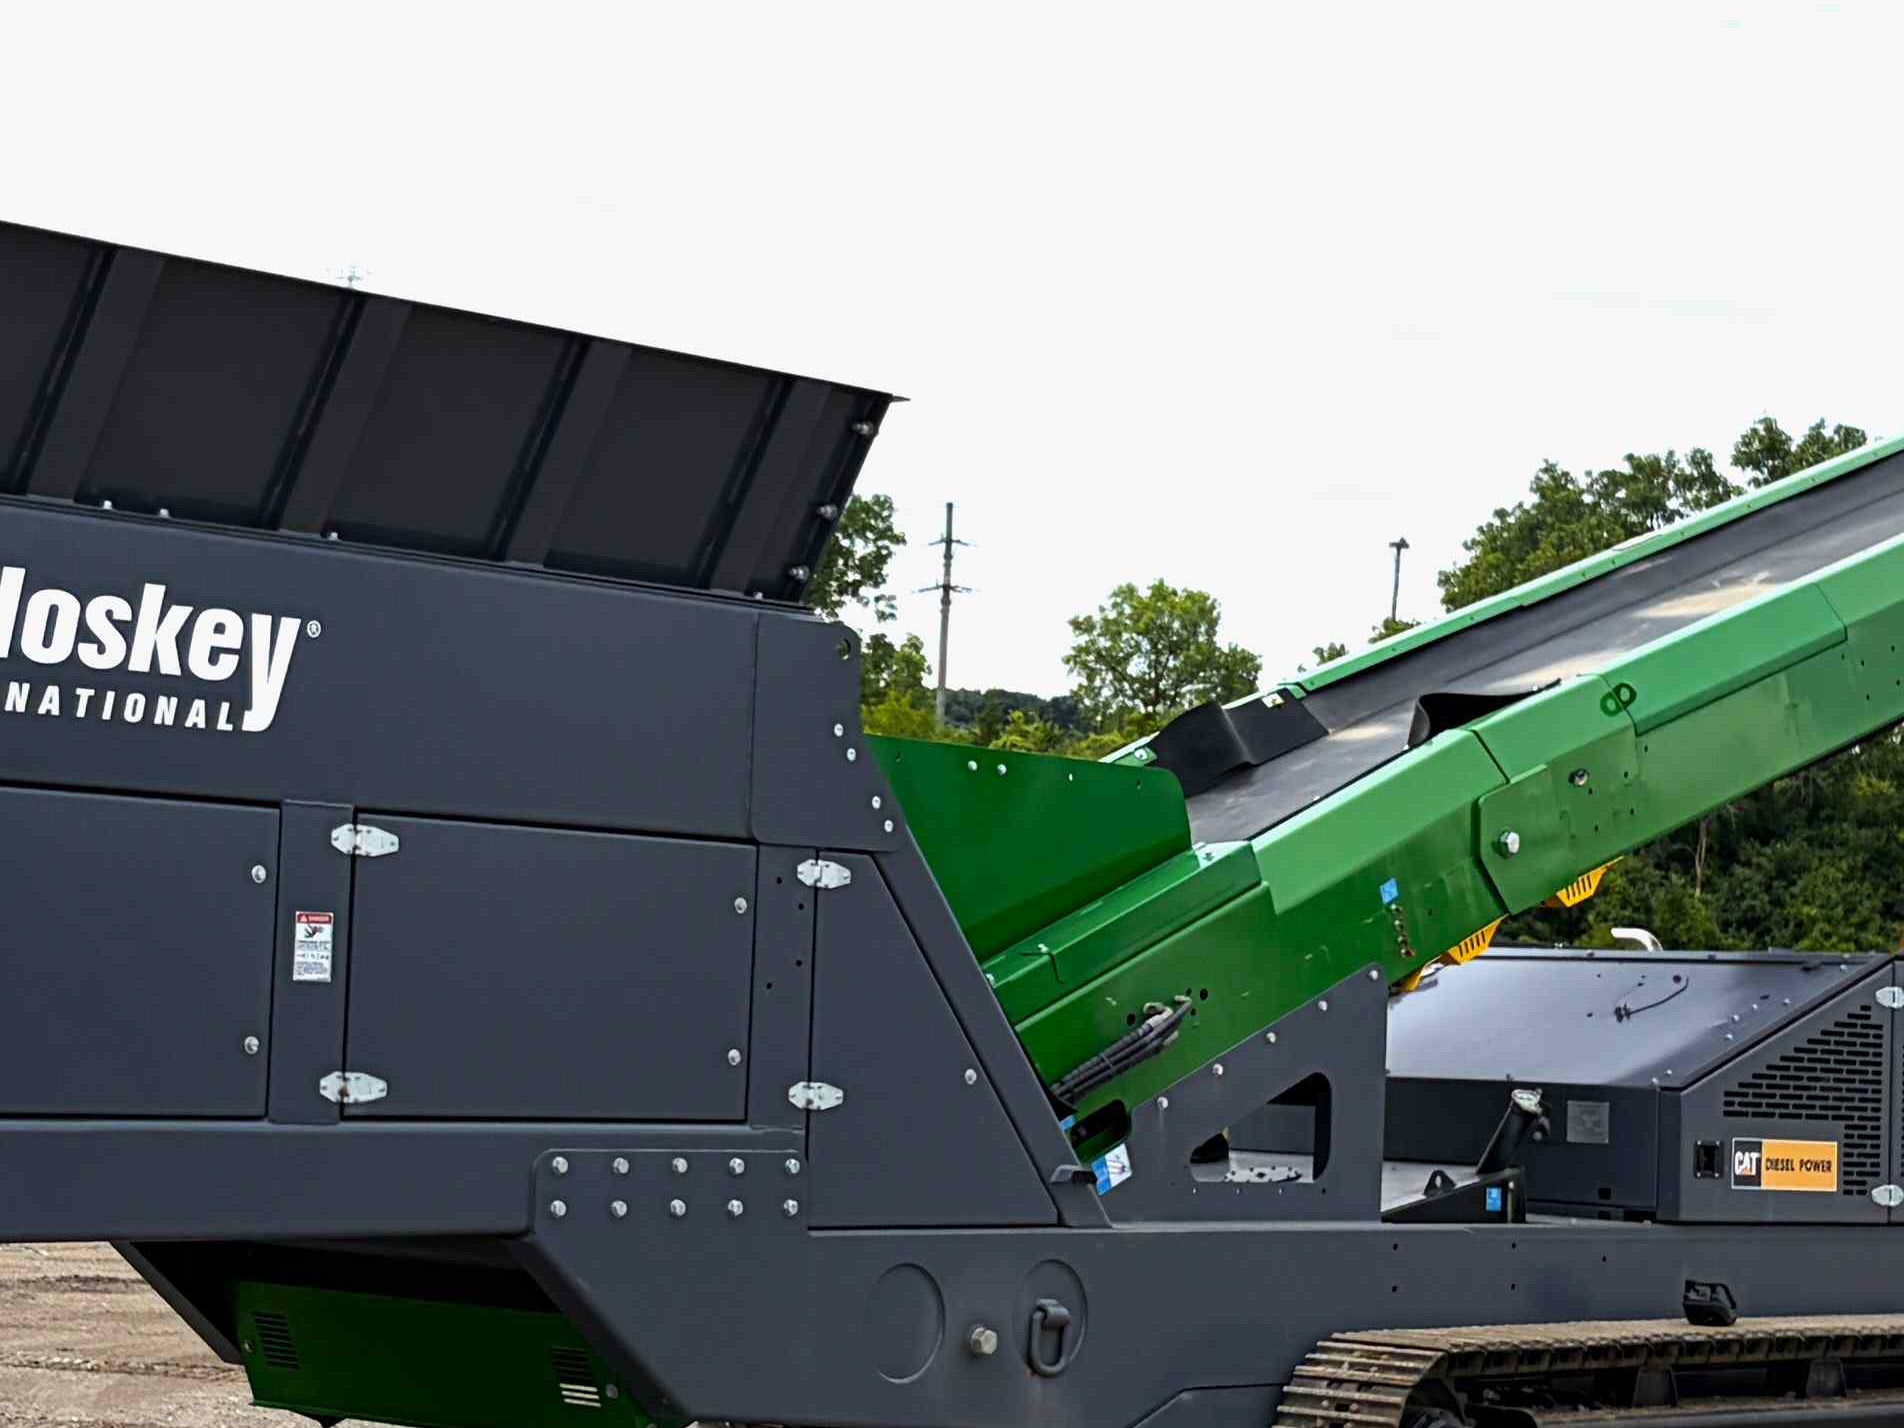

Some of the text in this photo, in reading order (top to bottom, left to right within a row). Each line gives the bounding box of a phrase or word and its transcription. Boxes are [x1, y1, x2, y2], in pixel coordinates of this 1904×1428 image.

[1734, 1150, 1761, 1176] CAT
[1765, 1157, 1832, 1173] DIESEL POWER
